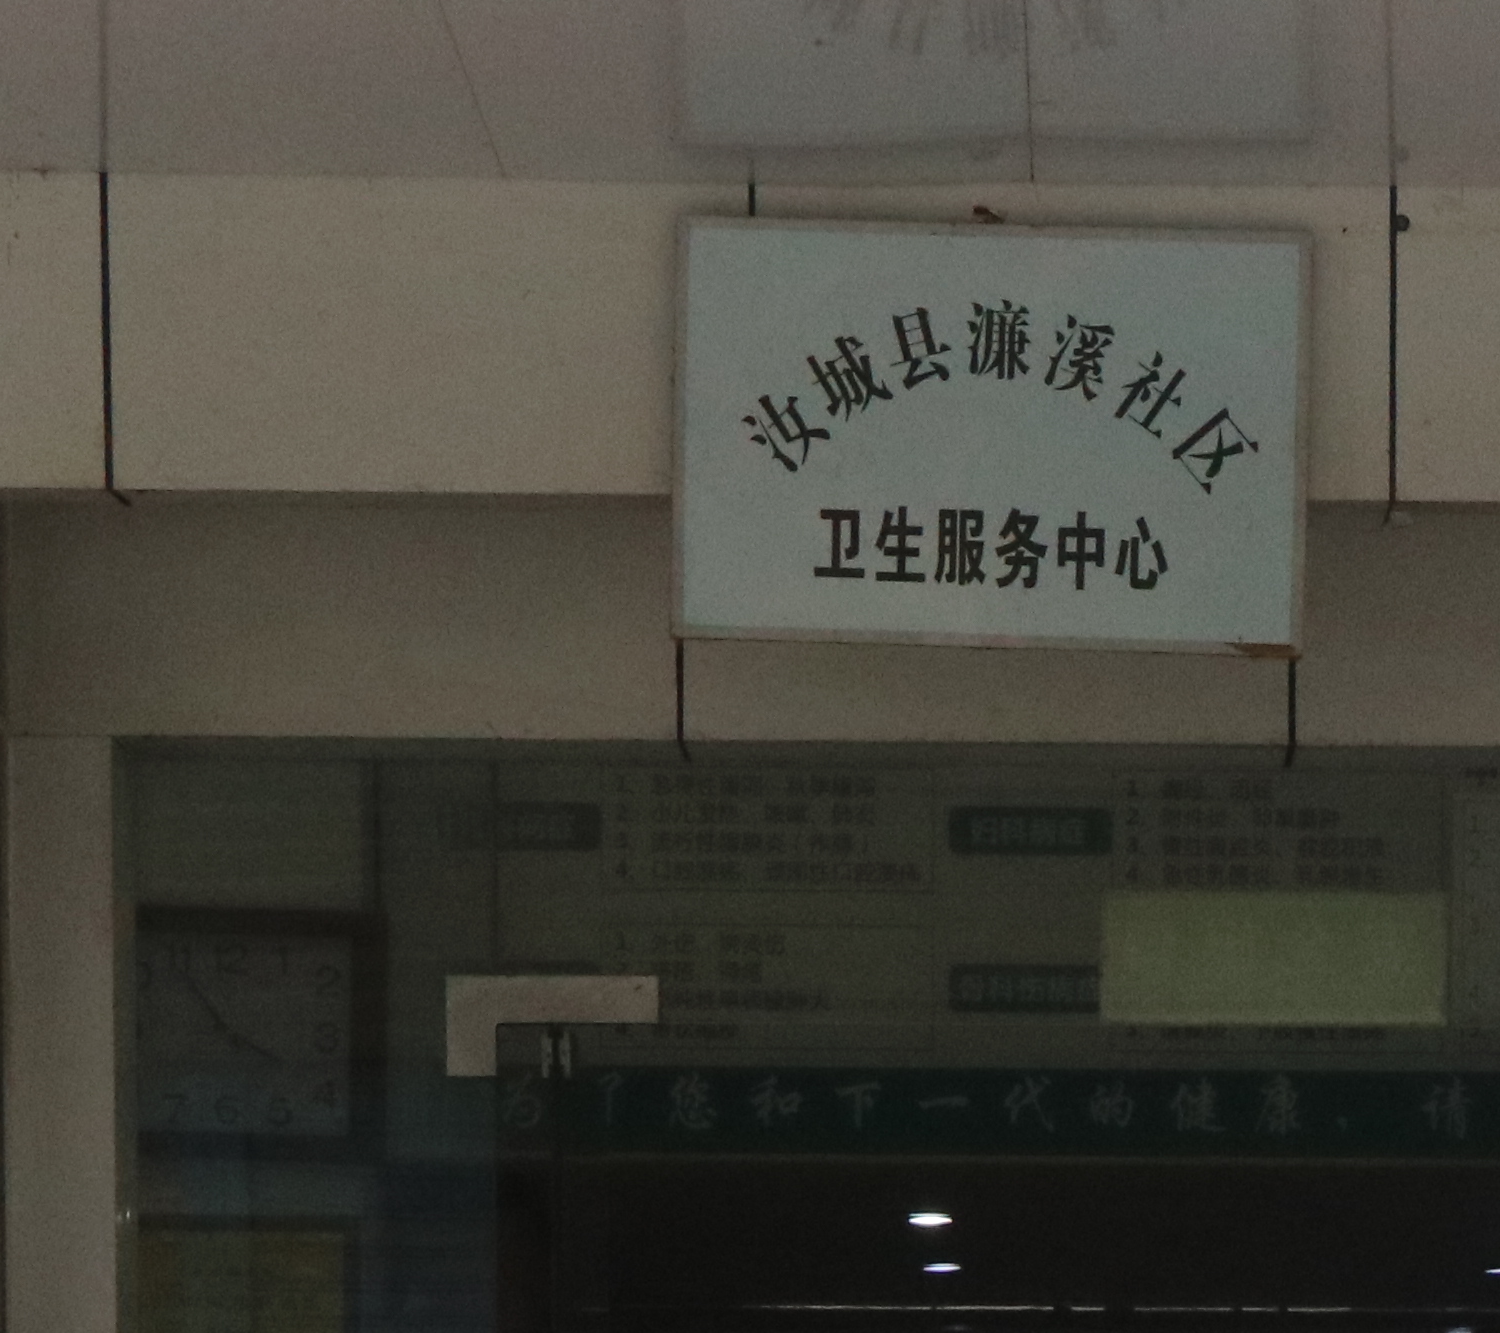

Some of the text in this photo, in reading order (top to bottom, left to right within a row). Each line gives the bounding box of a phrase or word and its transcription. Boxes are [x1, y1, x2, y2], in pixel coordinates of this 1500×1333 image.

[741, 298, 1260, 495] 汝城县濂溪社区
[813, 505, 1169, 592] 卫生服务中心
